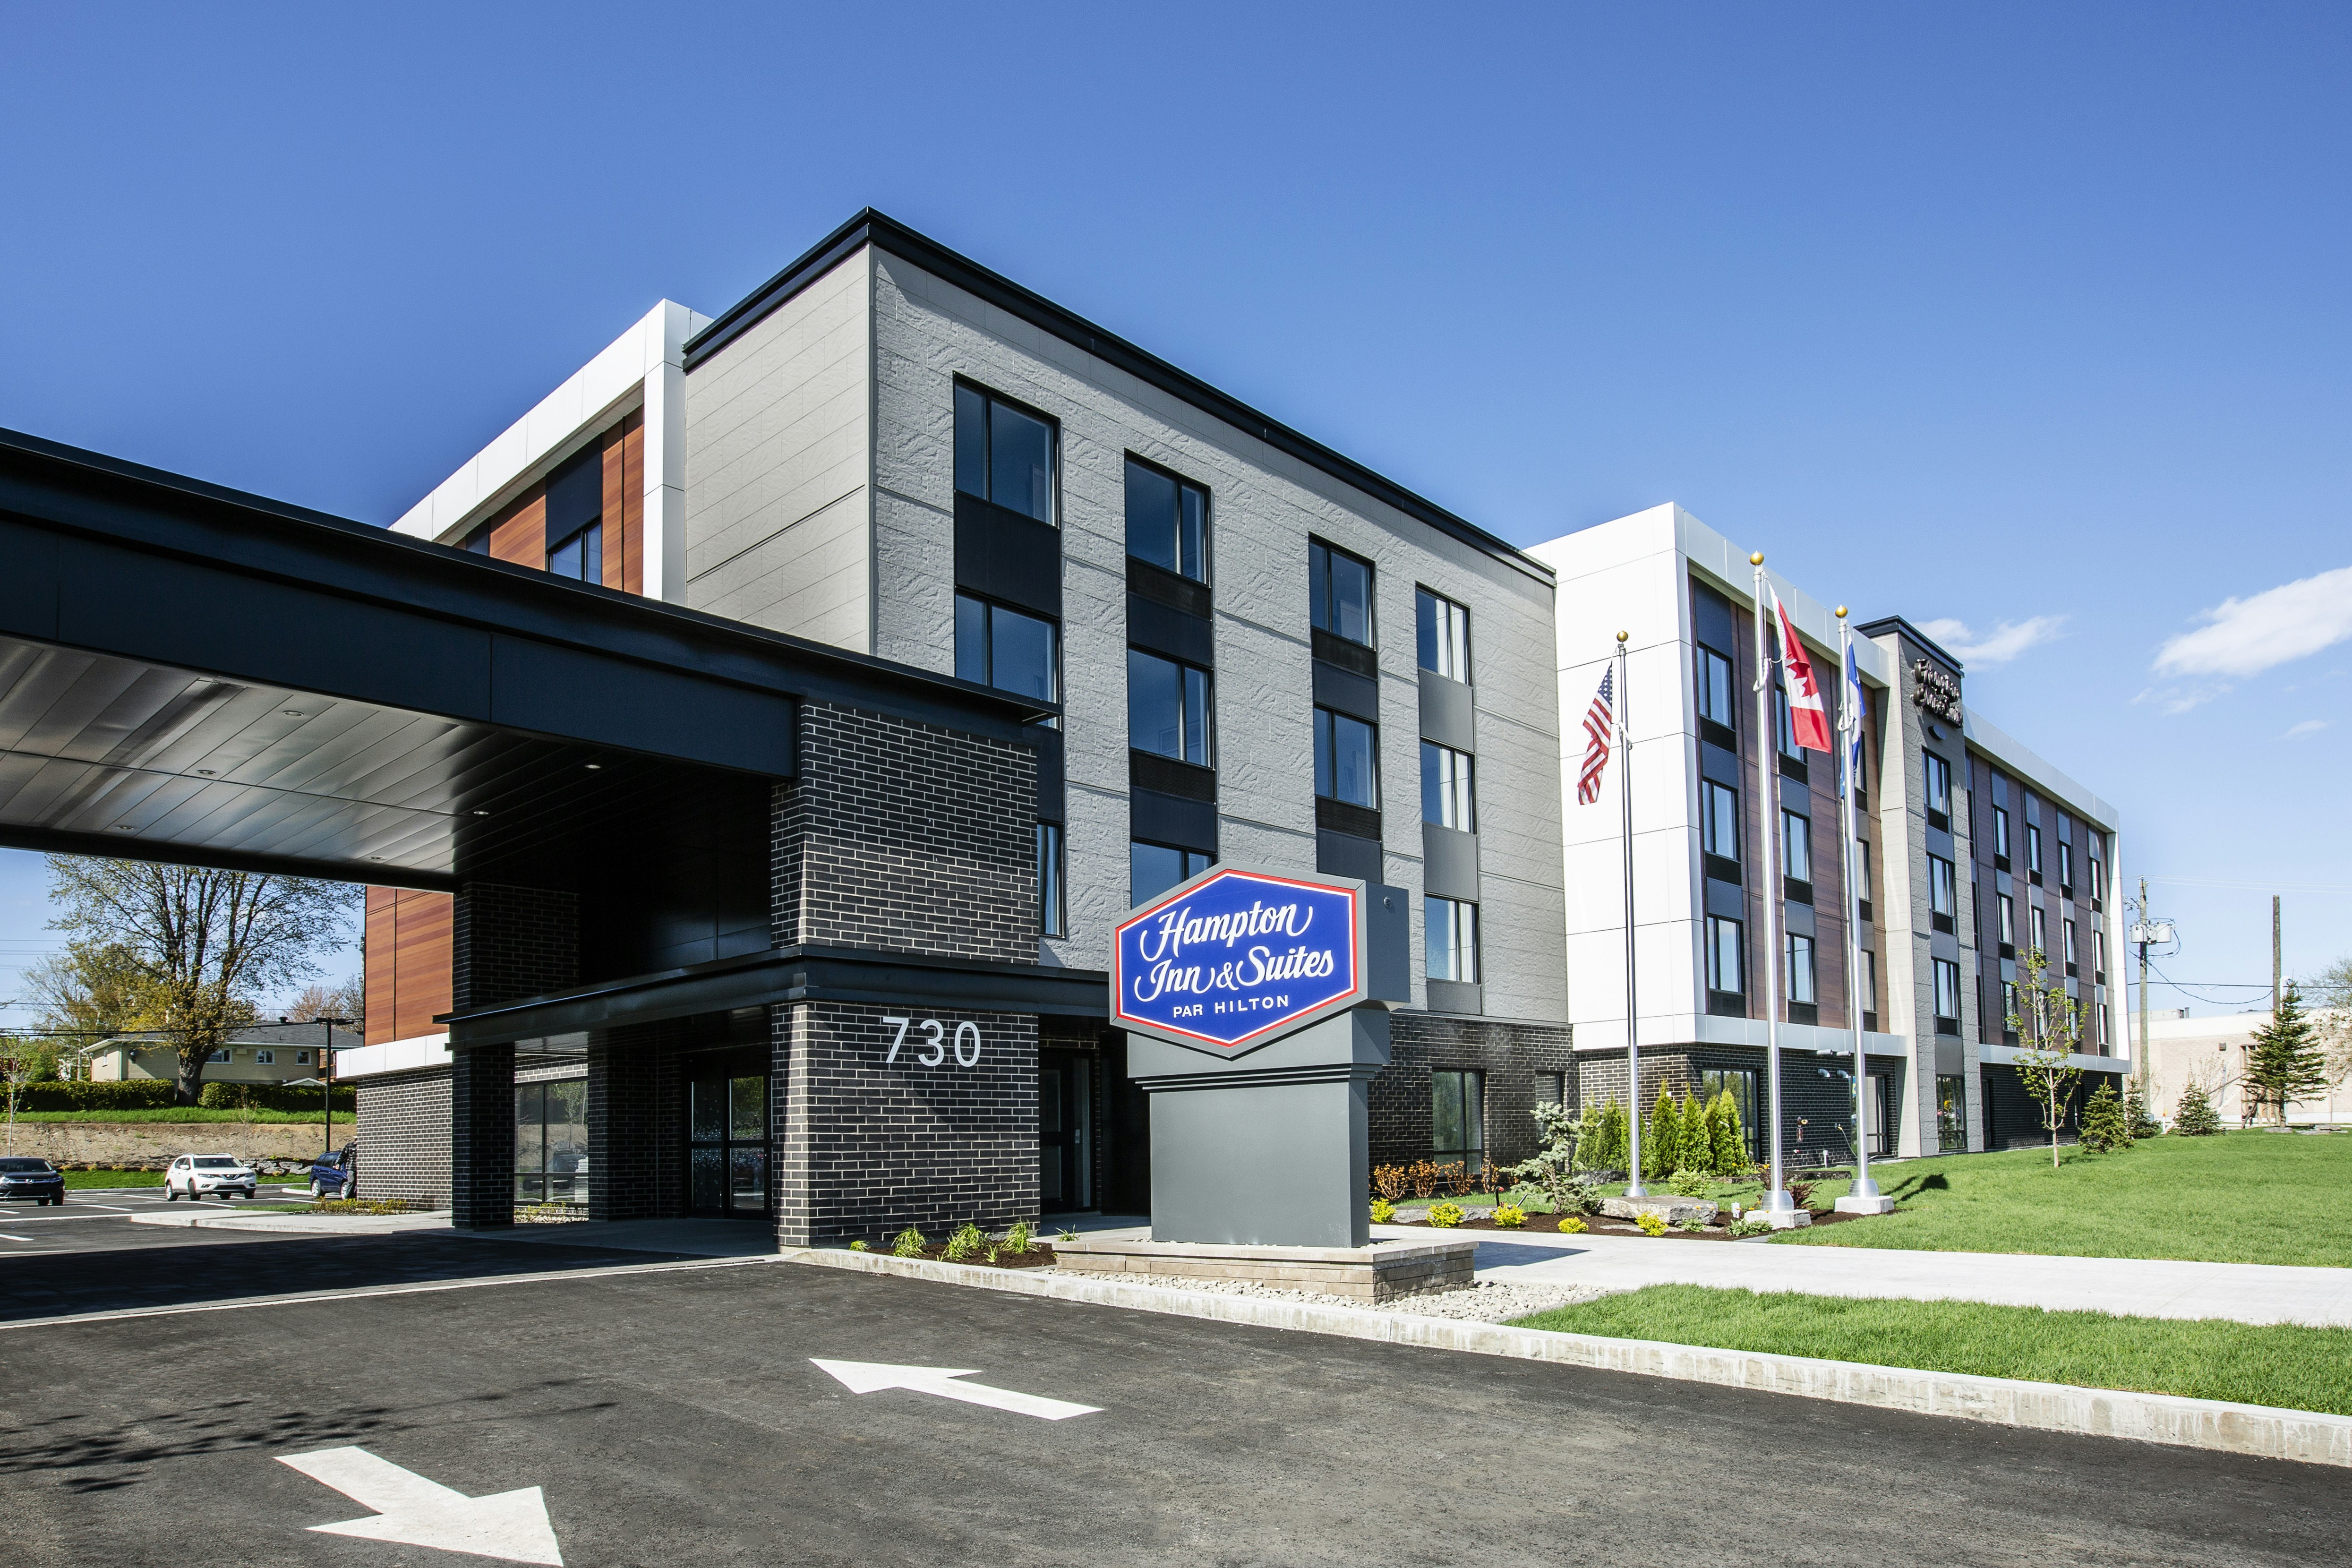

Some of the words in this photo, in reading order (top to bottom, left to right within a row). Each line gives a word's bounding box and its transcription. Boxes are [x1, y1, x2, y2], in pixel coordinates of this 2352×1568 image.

[1139, 900, 1313, 962] Hampton
[1134, 959, 1215, 1002] Inn
[1216, 962, 1239, 991] &
[1235, 945, 1334, 986] Suites
[1173, 1004, 1203, 1018] PAR
[1214, 994, 1288, 1014] HILTON
[882, 1016, 981, 1067] 730
